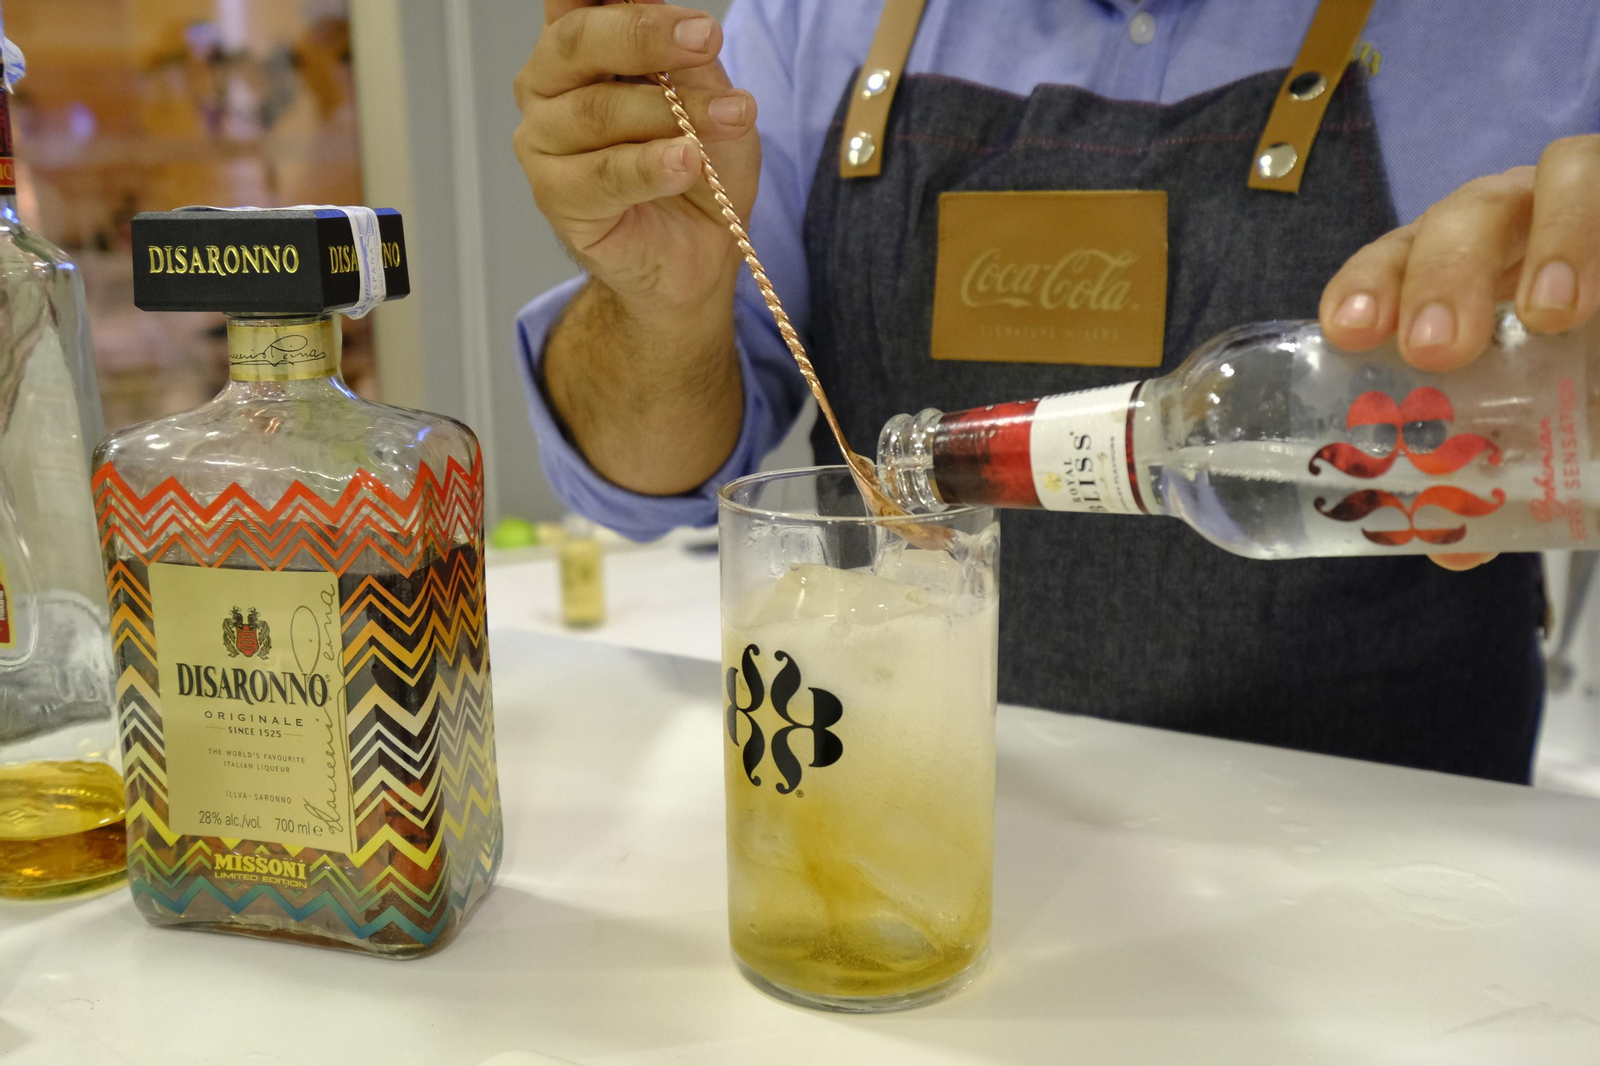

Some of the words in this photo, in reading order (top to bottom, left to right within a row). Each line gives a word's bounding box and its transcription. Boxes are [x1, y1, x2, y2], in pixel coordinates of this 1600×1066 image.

[148, 244, 300, 276] DISARONNO
[328, 241, 400, 274] DISANO
[961, 248, 1140, 311] Coca-Cola
[1063, 458, 1081, 503] ROYAL
[1073, 433, 1108, 512] BLISS
[175, 662, 328, 707] DISARONNO
[204, 710, 304, 727] ORIGINALE
[228, 726, 255, 736] SINCE
[259, 729, 282, 738] 1525
[208, 748, 222, 756] THE
[225, 750, 260, 760] WORLD'S
[263, 753, 306, 764] FAVOURITE
[223, 760, 253, 770] ITALIAN
[256, 763, 291, 773] LIQUEUR
[226, 790, 247, 799] ILLVA
[254, 793, 292, 804] SARONNO
[198, 810, 222, 826] 28%
[225, 813, 262, 829] alc./vol.
[275, 817, 295, 833] 700
[297, 822, 311, 835] ml
[214, 853, 307, 880] MISSONI
[214, 872, 259, 882] LIMITED
[262, 875, 308, 889] EDITION
